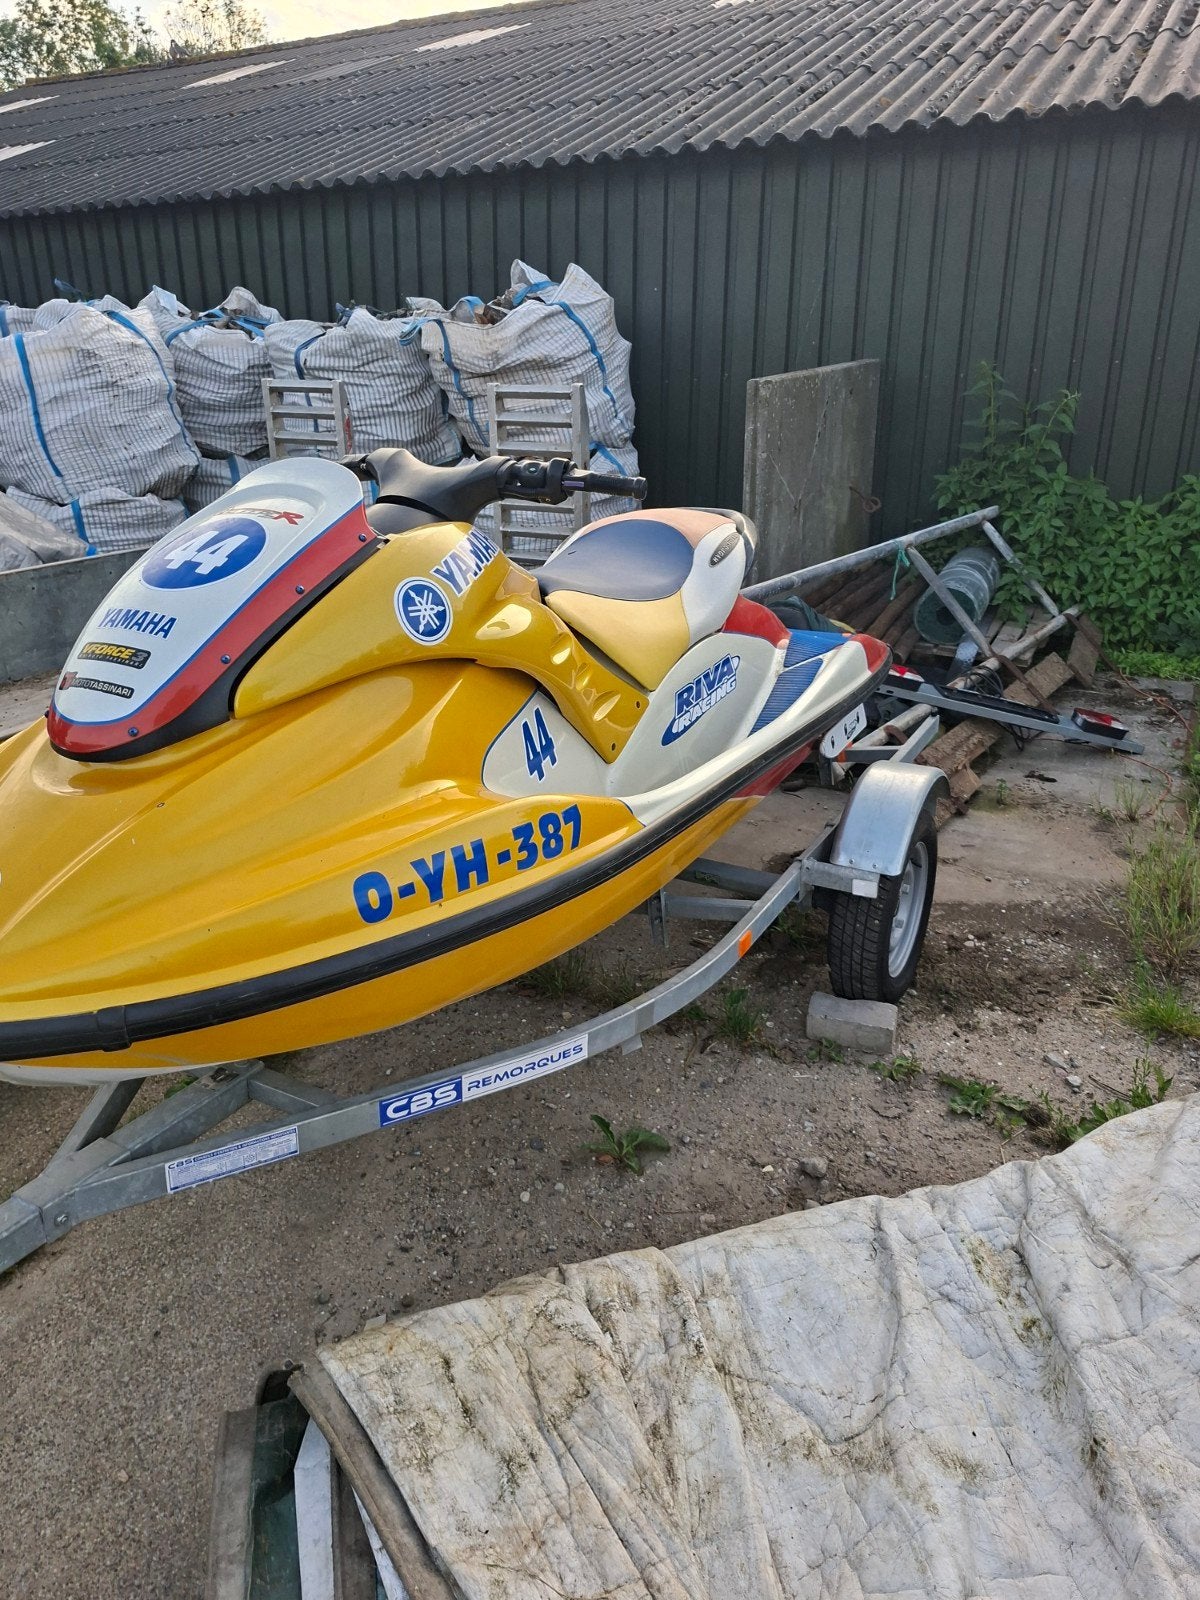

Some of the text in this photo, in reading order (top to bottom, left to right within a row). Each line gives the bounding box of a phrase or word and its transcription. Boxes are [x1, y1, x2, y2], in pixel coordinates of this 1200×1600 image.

[163, 530, 249, 574] 44
[431, 529, 499, 595] YAMAH
[83, 644, 148, 662] VFORCE 3
[98, 608, 177, 639] YAMAHA
[675, 654, 735, 719] RIVA
[676, 676, 736, 733] RACING
[522, 707, 558, 782] 44
[386, 1044, 583, 1119] CBS REMORQUES
